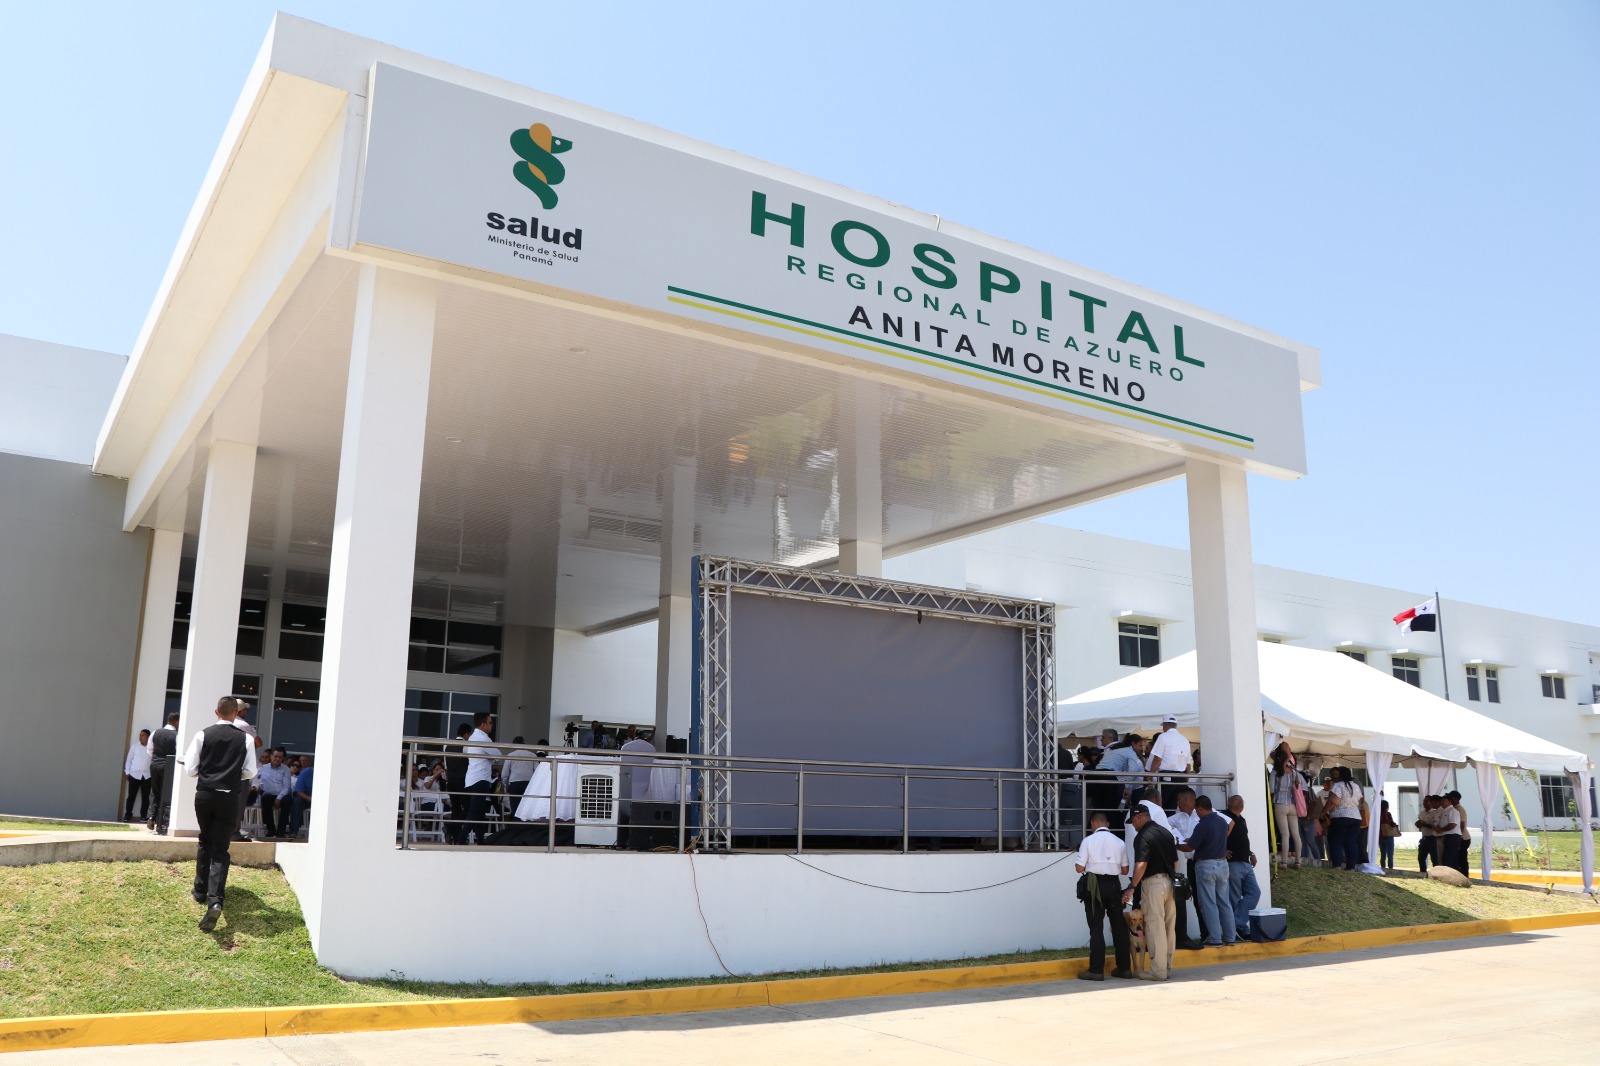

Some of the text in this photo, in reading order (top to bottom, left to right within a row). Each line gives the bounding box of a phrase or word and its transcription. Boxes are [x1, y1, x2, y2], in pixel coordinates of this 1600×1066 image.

[485, 212, 583, 251] salud
[487, 234, 579, 263] Ministerio de Salud
[513, 250, 553, 266] Panamá
[750, 190, 1206, 368] HOSPITAL
[787, 254, 1185, 382] REGIONAL DE AZUERO
[848, 305, 1146, 402] ANITA MORENO
